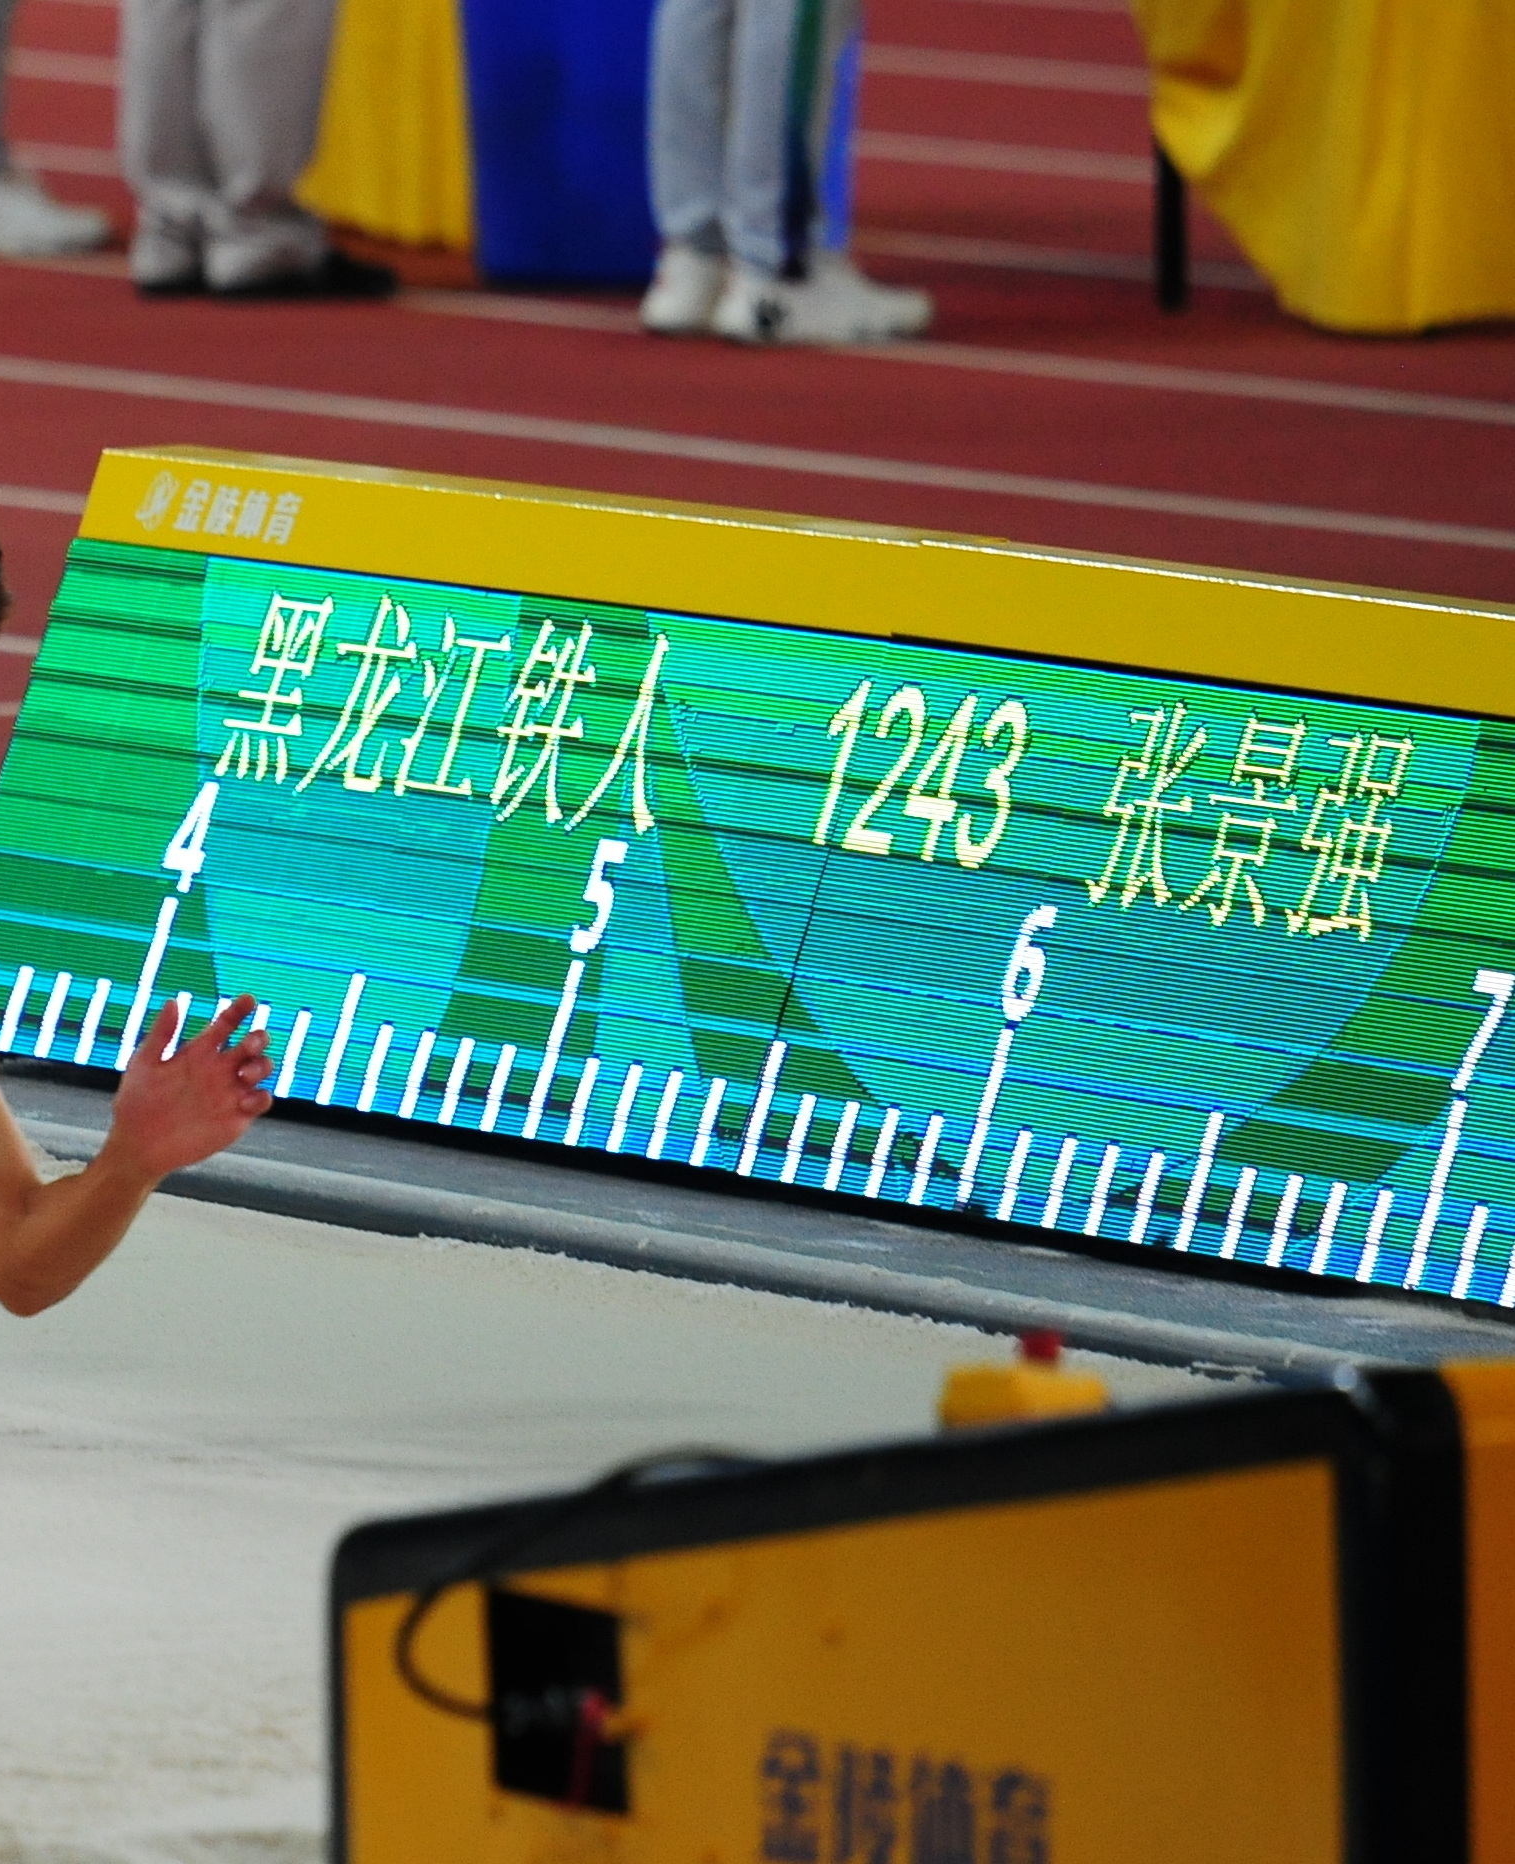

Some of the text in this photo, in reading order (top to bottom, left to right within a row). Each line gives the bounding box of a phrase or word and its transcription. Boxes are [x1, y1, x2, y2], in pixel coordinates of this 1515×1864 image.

[213, 592, 1417, 943] 黑龙江铁人 1243 张景强
[162, 781, 1515, 1092] 4 5 6 7
